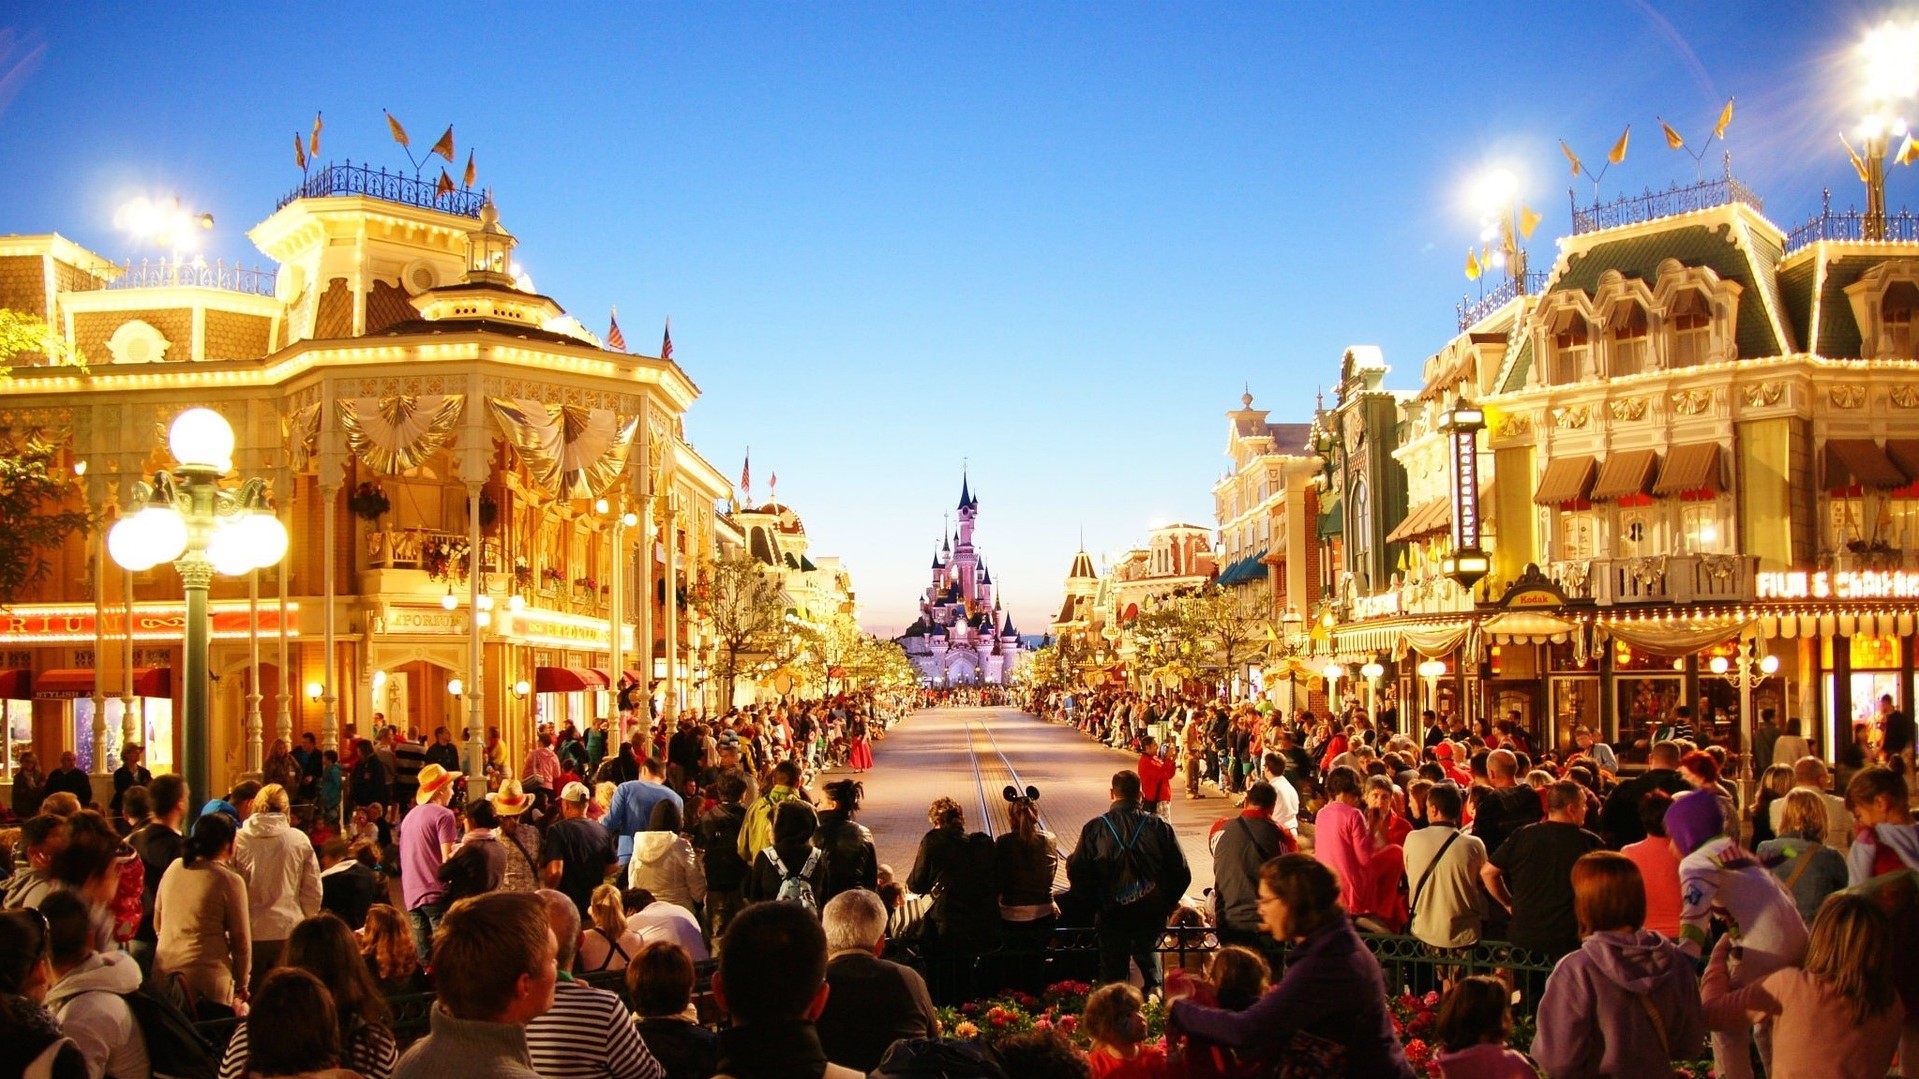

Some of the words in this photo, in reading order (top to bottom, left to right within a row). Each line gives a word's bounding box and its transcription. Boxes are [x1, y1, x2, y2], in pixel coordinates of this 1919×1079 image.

[1460, 434, 1475, 547] PHOTOGRAPHY
[1755, 571, 1807, 598] FILM
[1520, 595, 1548, 604] Kodak
